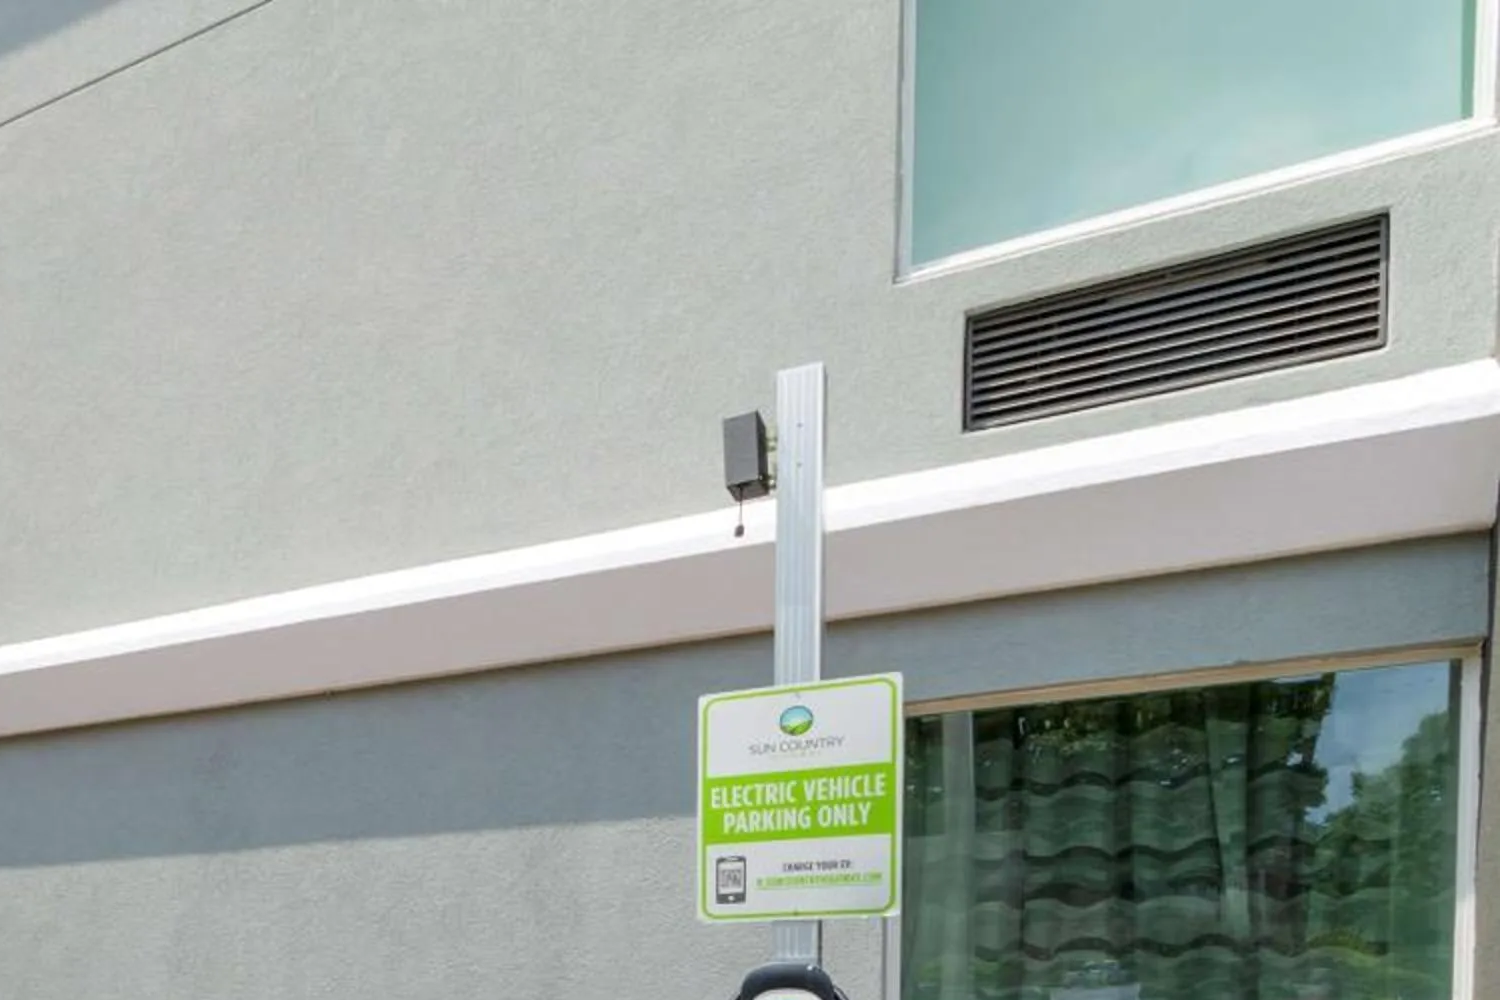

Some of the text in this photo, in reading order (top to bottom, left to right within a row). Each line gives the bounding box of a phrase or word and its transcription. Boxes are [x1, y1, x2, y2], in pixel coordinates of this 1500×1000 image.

[749, 743, 777, 756] SUN
[779, 735, 845, 753] COUNTRY
[711, 772, 886, 809] ELECTRIC VEHICLE
[723, 801, 871, 834] PARKING ONLY
